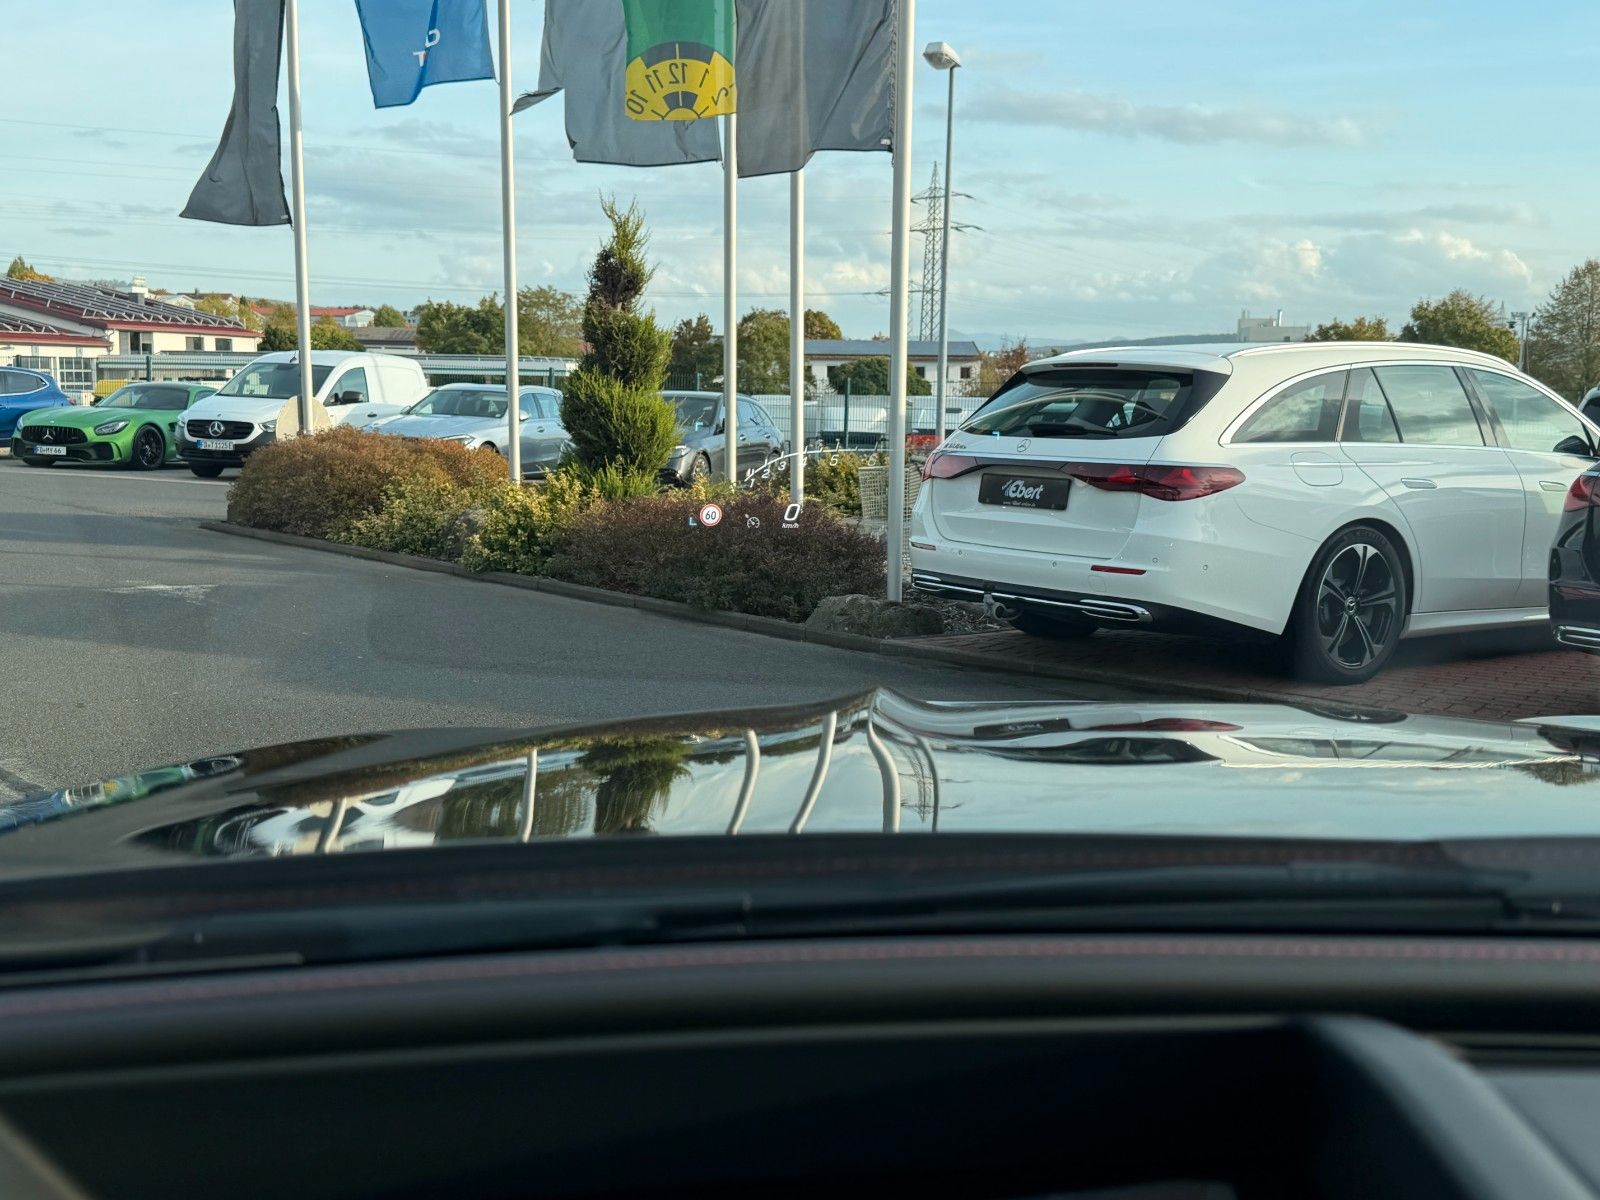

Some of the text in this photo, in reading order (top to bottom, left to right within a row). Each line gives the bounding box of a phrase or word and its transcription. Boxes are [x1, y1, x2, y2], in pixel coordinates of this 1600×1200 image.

[761, 468, 771, 479] 2
[777, 461, 787, 471] 3
[829, 454, 840, 466] 5
[1005, 479, 1044, 499] Ebert
[705, 510, 717, 520] 60
[783, 503, 801, 521] 0
